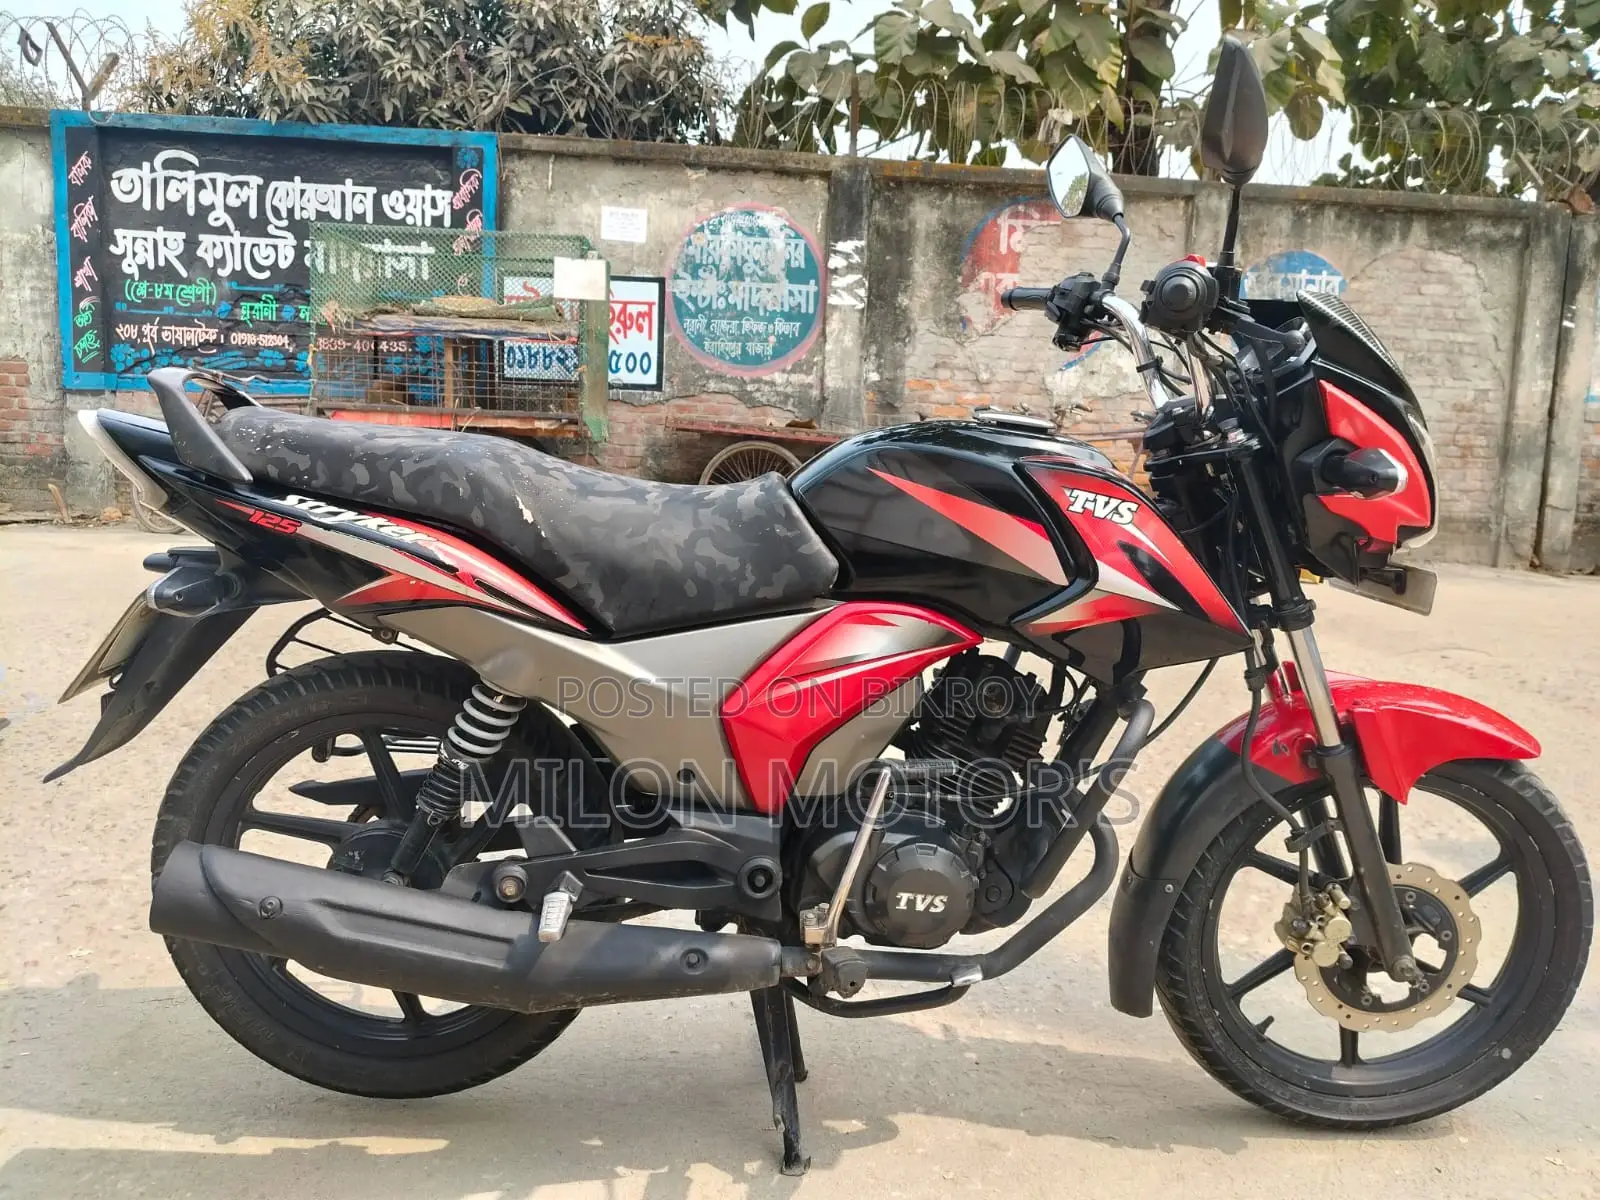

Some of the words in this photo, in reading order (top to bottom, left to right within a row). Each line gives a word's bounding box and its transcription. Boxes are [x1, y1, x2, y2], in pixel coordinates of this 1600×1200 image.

[68, 150, 93, 186] বালক
[110, 149, 264, 232] তালিমুল
[265, 175, 377, 227] কোরআন
[70, 194, 99, 243] বালিকা
[109, 226, 188, 281] সুন্নাহ
[196, 224, 297, 280] ক্যাডেট
[74, 255, 98, 292] শাখা
[247, 509, 302, 534] 125
[1063, 487, 1140, 525] TVS
[895, 892, 949, 913] TVS
